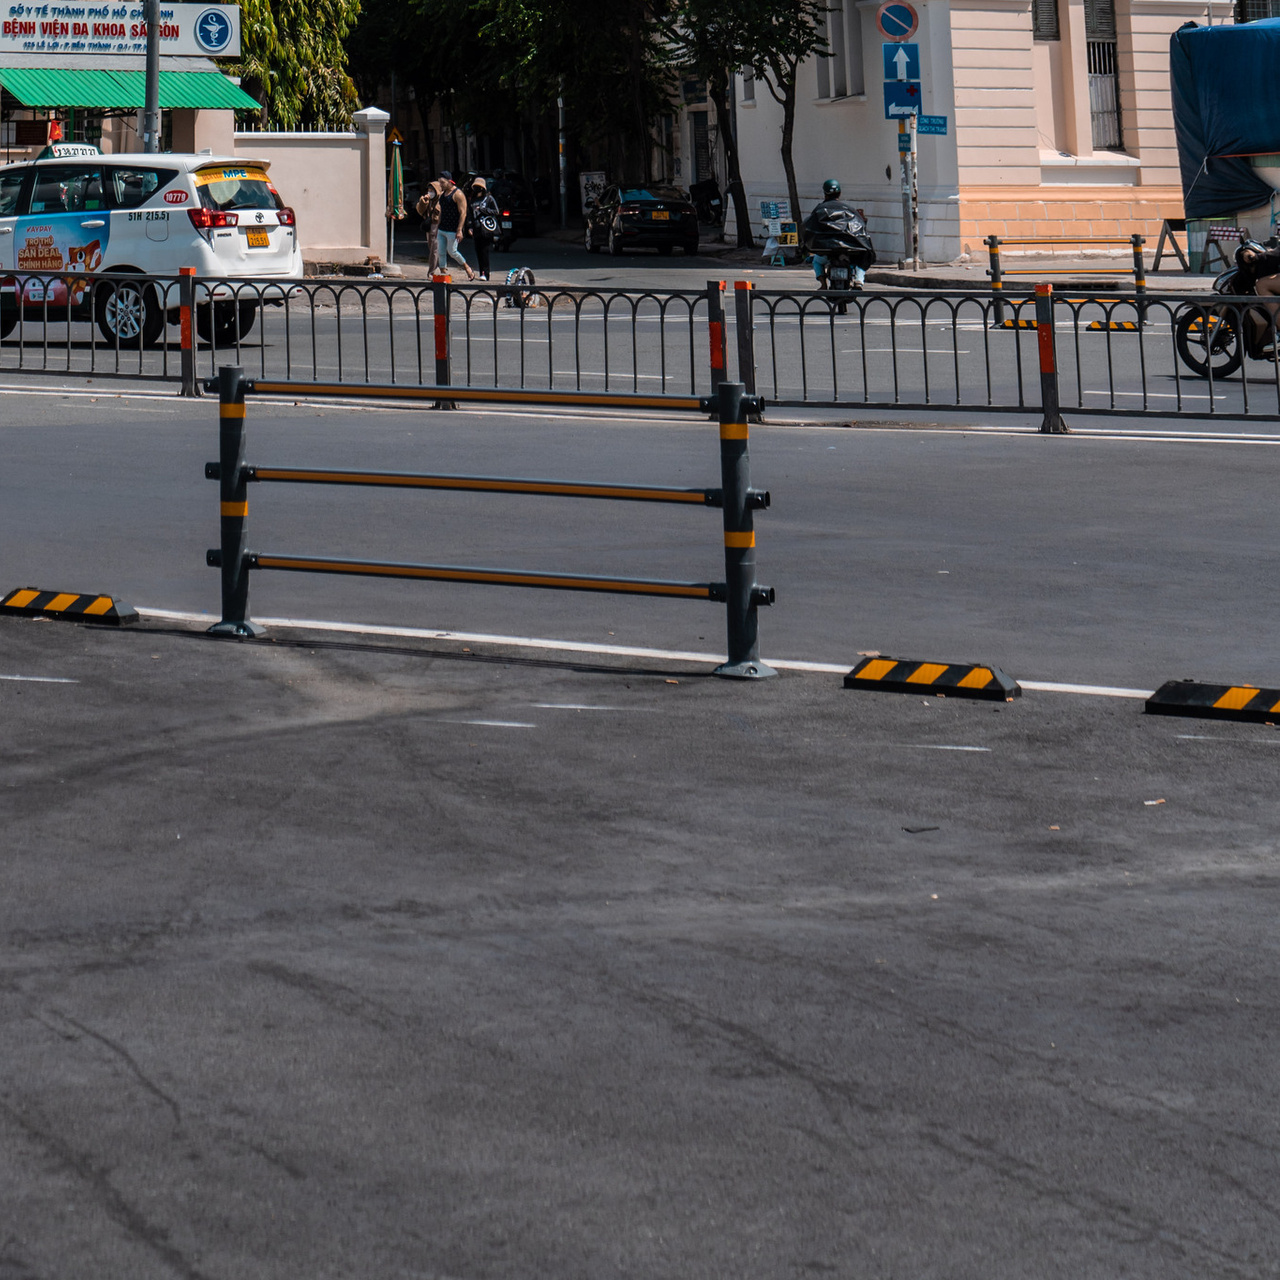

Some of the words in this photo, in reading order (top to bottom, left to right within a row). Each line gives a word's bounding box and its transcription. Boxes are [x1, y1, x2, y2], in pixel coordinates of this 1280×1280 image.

[10, 4, 24, 14] SỞ
[36, 4, 48, 14] TẾ
[52, 6, 85, 15] THÀNH
[88, 5, 109, 17] PHỐ
[113, 5, 127, 16] HỒ
[3, 18, 36, 39] BỆNH
[42, 19, 70, 38] VIỆN
[73, 22, 89, 36] ĐA
[94, 23, 126, 37] KHOA
[132, 21, 147, 37] SÀ
[223, 169, 247, 178] MPE
[166, 193, 186, 202] 10779
[128, 212, 142, 221] 51H
[146, 211, 169, 221] 215.51
[25, 238, 38, 246] TRỢ
[41, 235, 53, 244] THỦ
[38, 249, 61, 257] DEAL
[18, 259, 40, 268] CHÍNH
